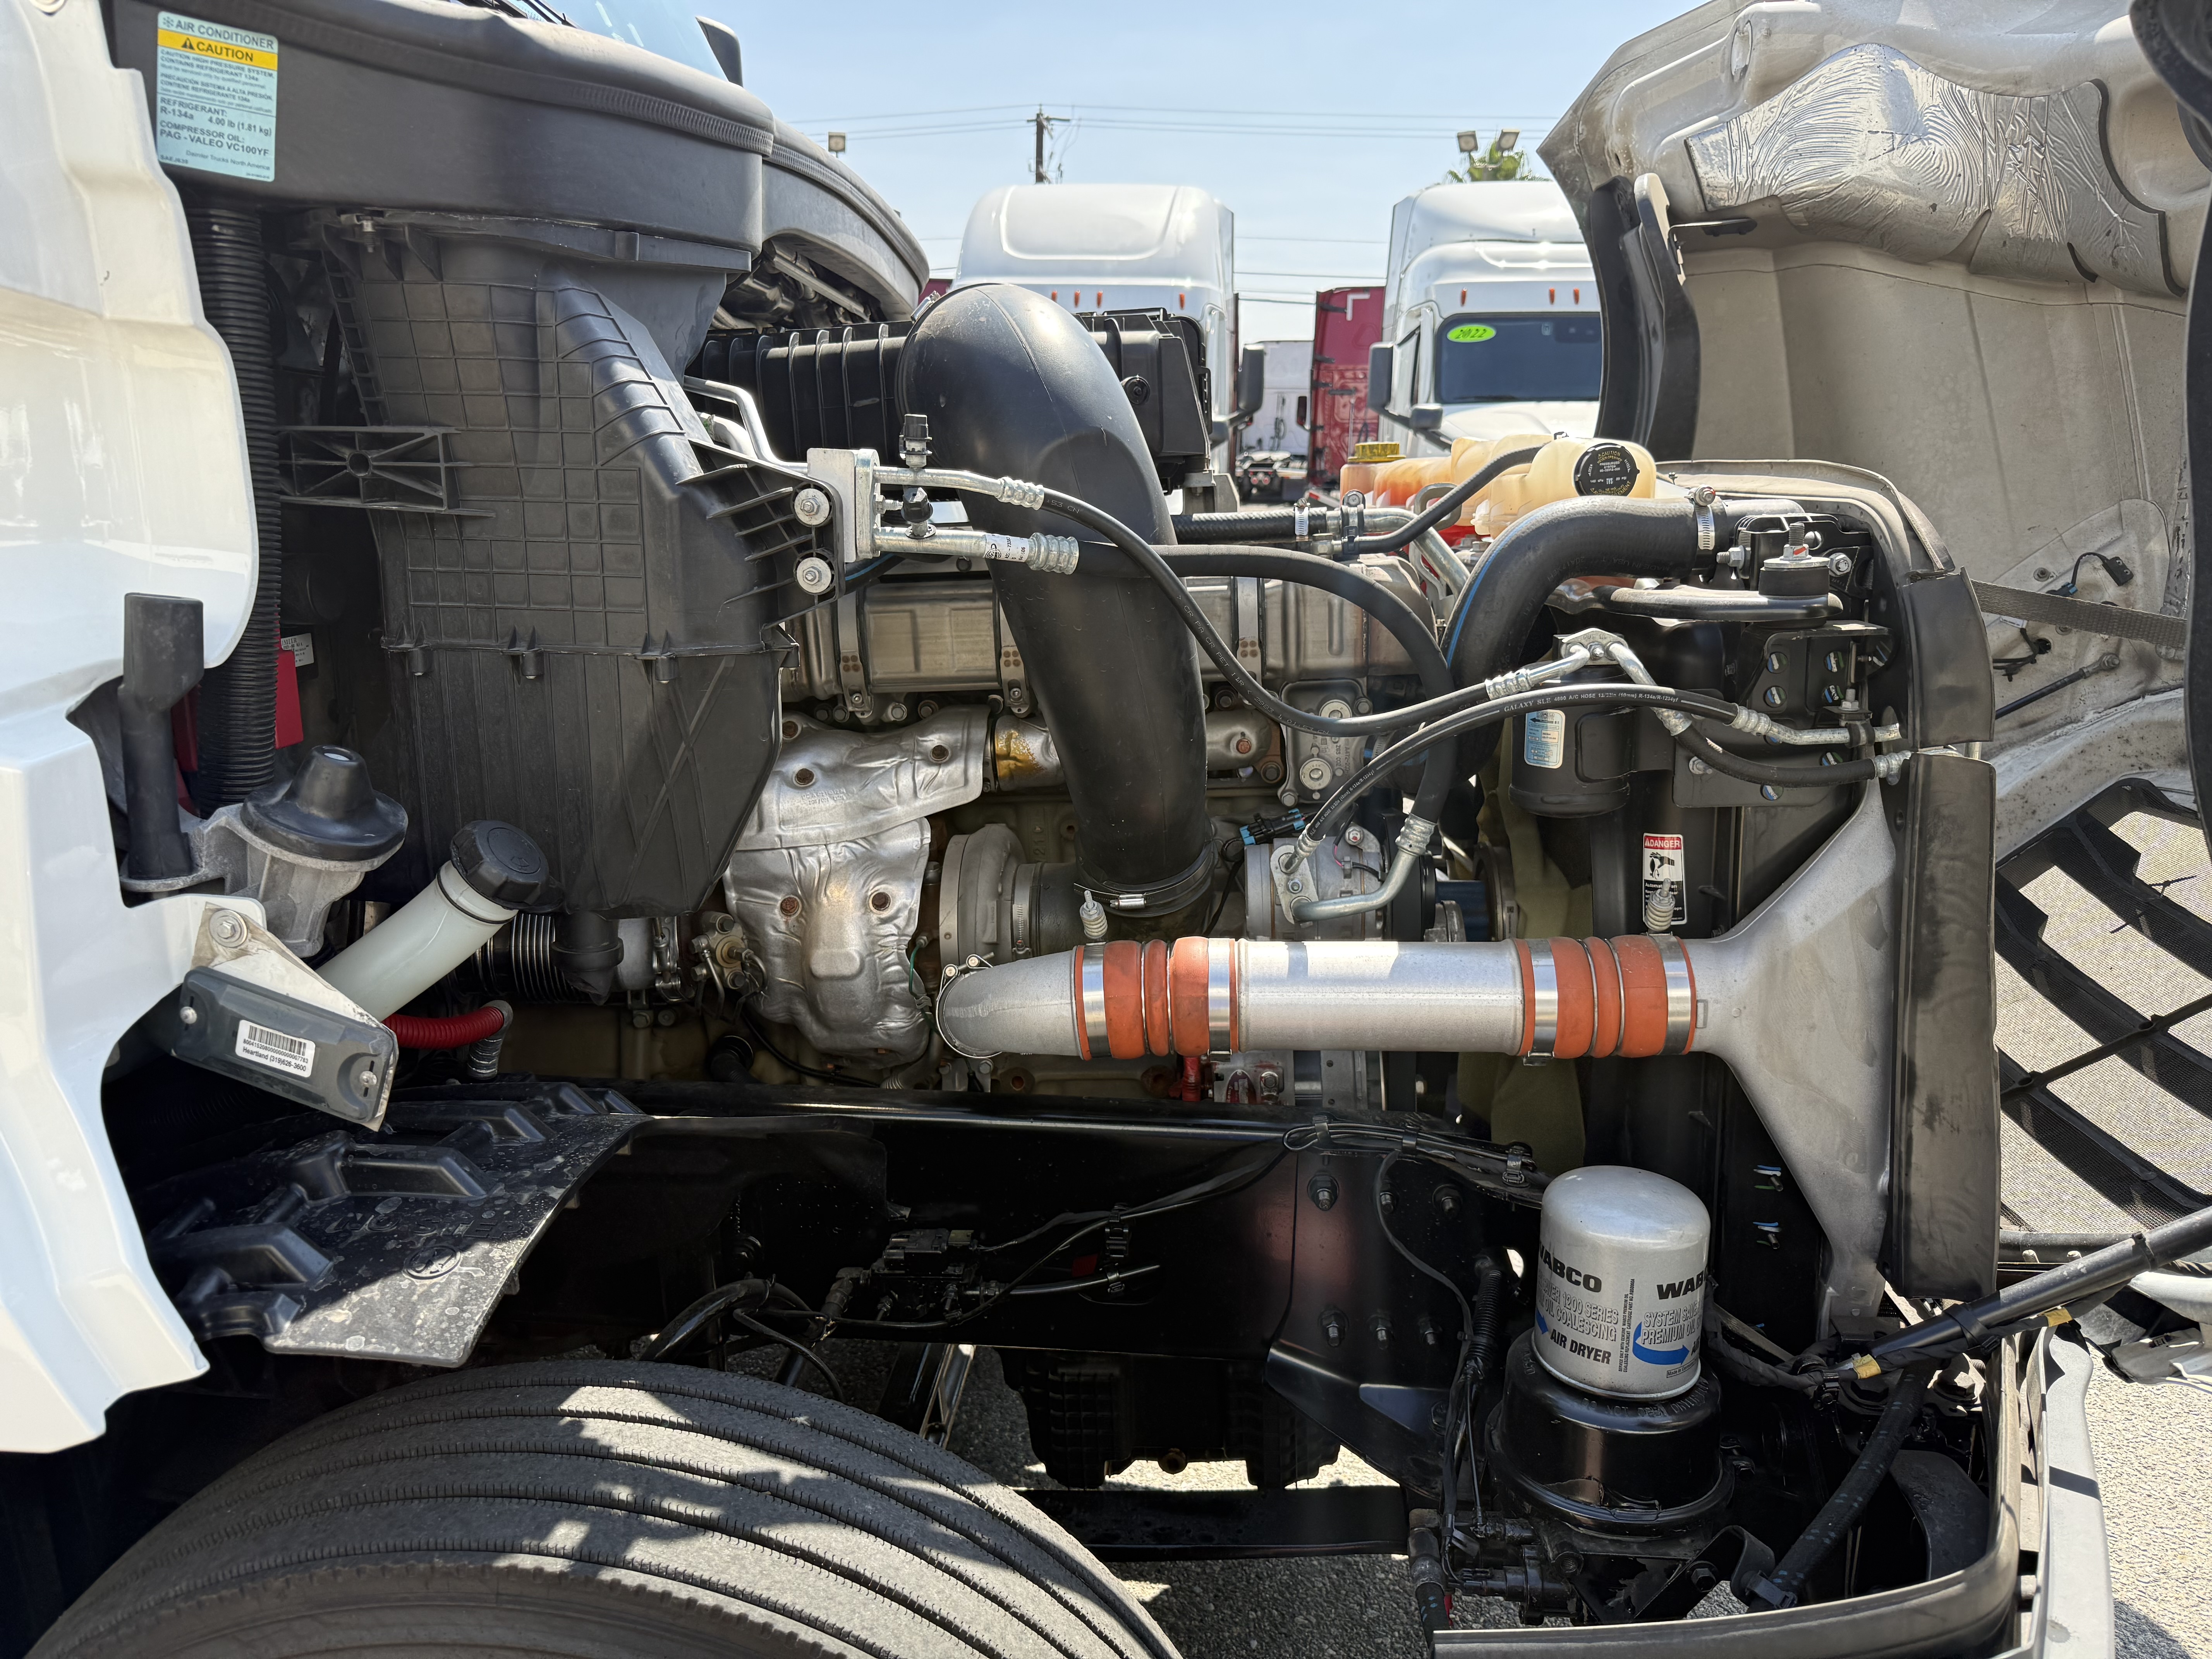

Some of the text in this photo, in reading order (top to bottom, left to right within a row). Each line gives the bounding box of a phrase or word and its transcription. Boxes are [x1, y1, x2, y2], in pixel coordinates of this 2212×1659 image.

[175, 20, 274, 50] AIR CONDITIONER
[196, 41, 253, 62] CAUTION
[160, 97, 227, 117] REFRIGERANT:
[160, 106, 272, 137] R-134a 4.00 lb (1.81 kg)
[160, 120, 245, 143] COMPRESSOR OIL:
[160, 129, 181, 140] PAG
[189, 134, 224, 148] VALEO
[227, 141, 270, 156] VC100YF
[1455, 328, 1487, 339] 2022
[1067, 505, 1080, 514] CN
[1183, 605, 1194, 617] CR
[1194, 620, 1204, 633] PA
[1205, 637, 1215, 649] CR
[1216, 651, 1230, 667] PET
[1504, 700, 1534, 712] GALAXY
[1537, 697, 1551, 706] SLE
[1638, 693, 1679, 703] R-134a/R-1234yf
[1650, 840, 1680, 848] DANGER
[243, 1046, 269, 1060] Heartland
[1656, 1270, 1704, 1300] WAB
[1544, 1295, 1554, 1317] OIL
[1556, 1305, 1616, 1342] COALESCING
[1563, 1291, 1583, 1314] 1200
[1584, 1302, 1619, 1324] SERIES
[1644, 1308, 1681, 1328] SYSTEM
[1642, 1323, 1685, 1345] PREMIUM
[1685, 1317, 1695, 1336] OIL
[1549, 1328, 1611, 1365] AIR DRYER
[1668, 1368, 1678, 1376] Made
